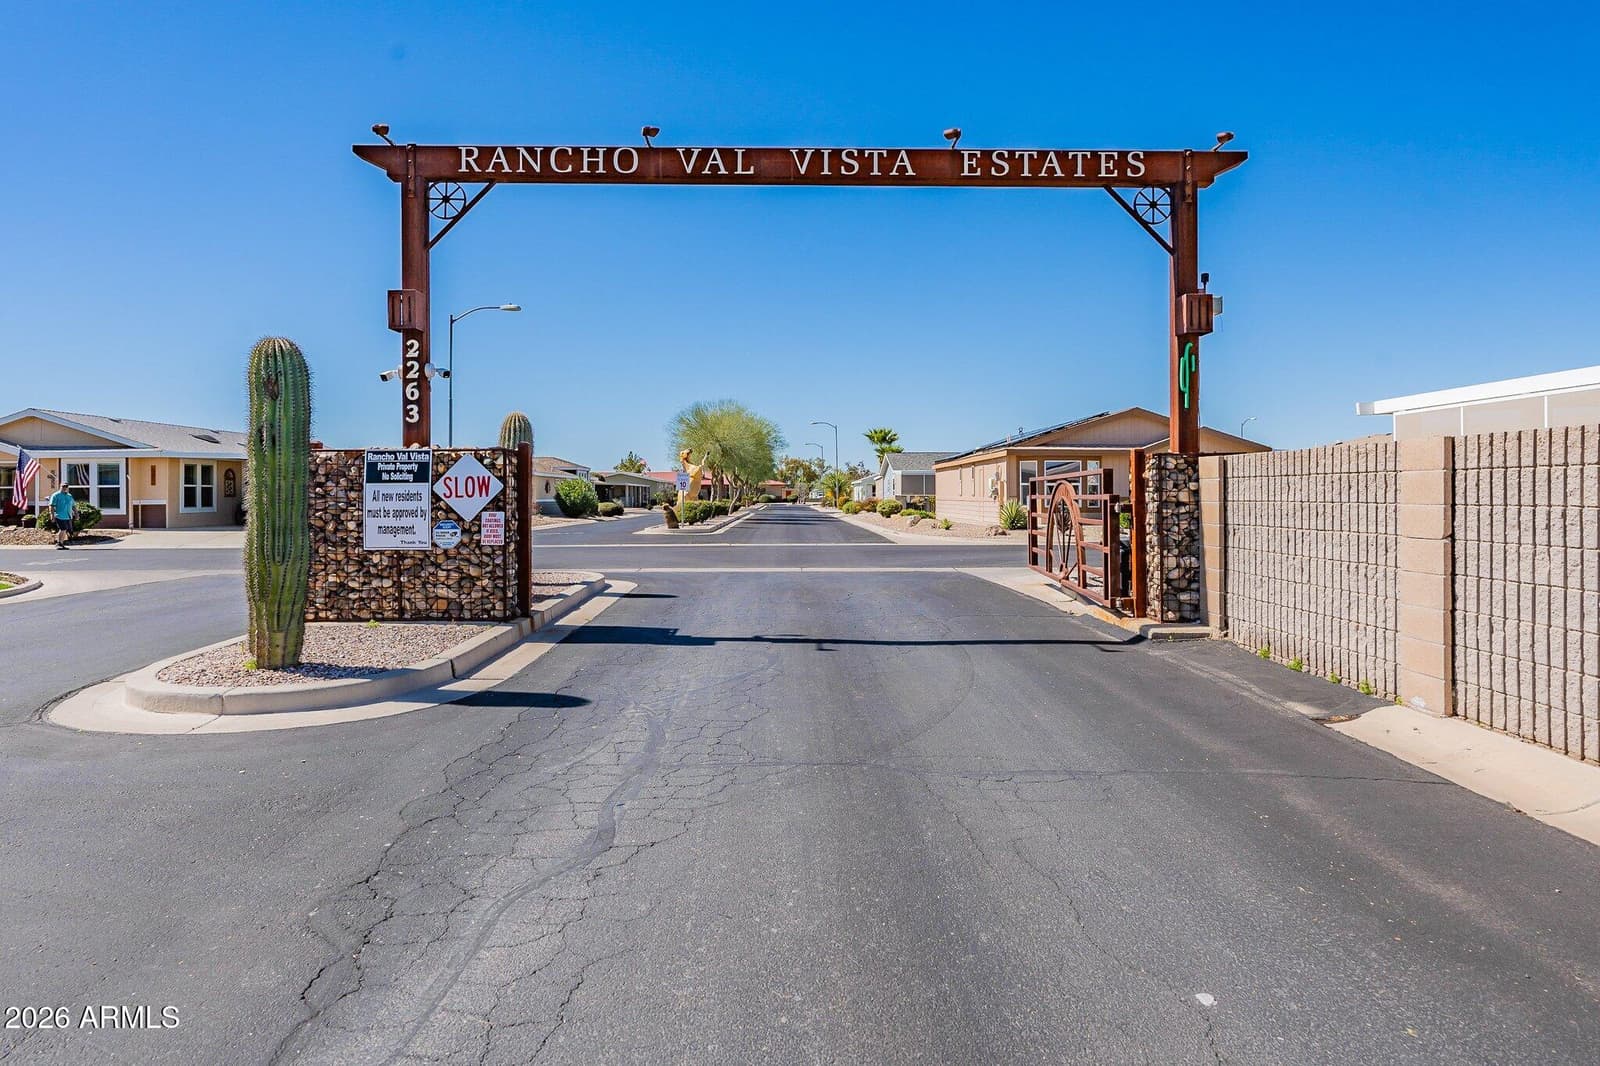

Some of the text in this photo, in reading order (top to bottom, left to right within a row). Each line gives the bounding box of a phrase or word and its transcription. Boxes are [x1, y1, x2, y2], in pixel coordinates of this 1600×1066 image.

[458, 145, 1146, 178] RANCHO VAL VISTA ESTATES
[405, 339, 420, 423] 2263
[367, 452, 430, 461] Rancho Val Vista
[377, 462, 418, 472] Private Property
[382, 472, 414, 482] No Soliciting
[443, 475, 491, 499] SLOW
[372, 489, 423, 502] All new residents
[366, 506, 427, 521] must be approved by
[377, 524, 417, 538] management.
